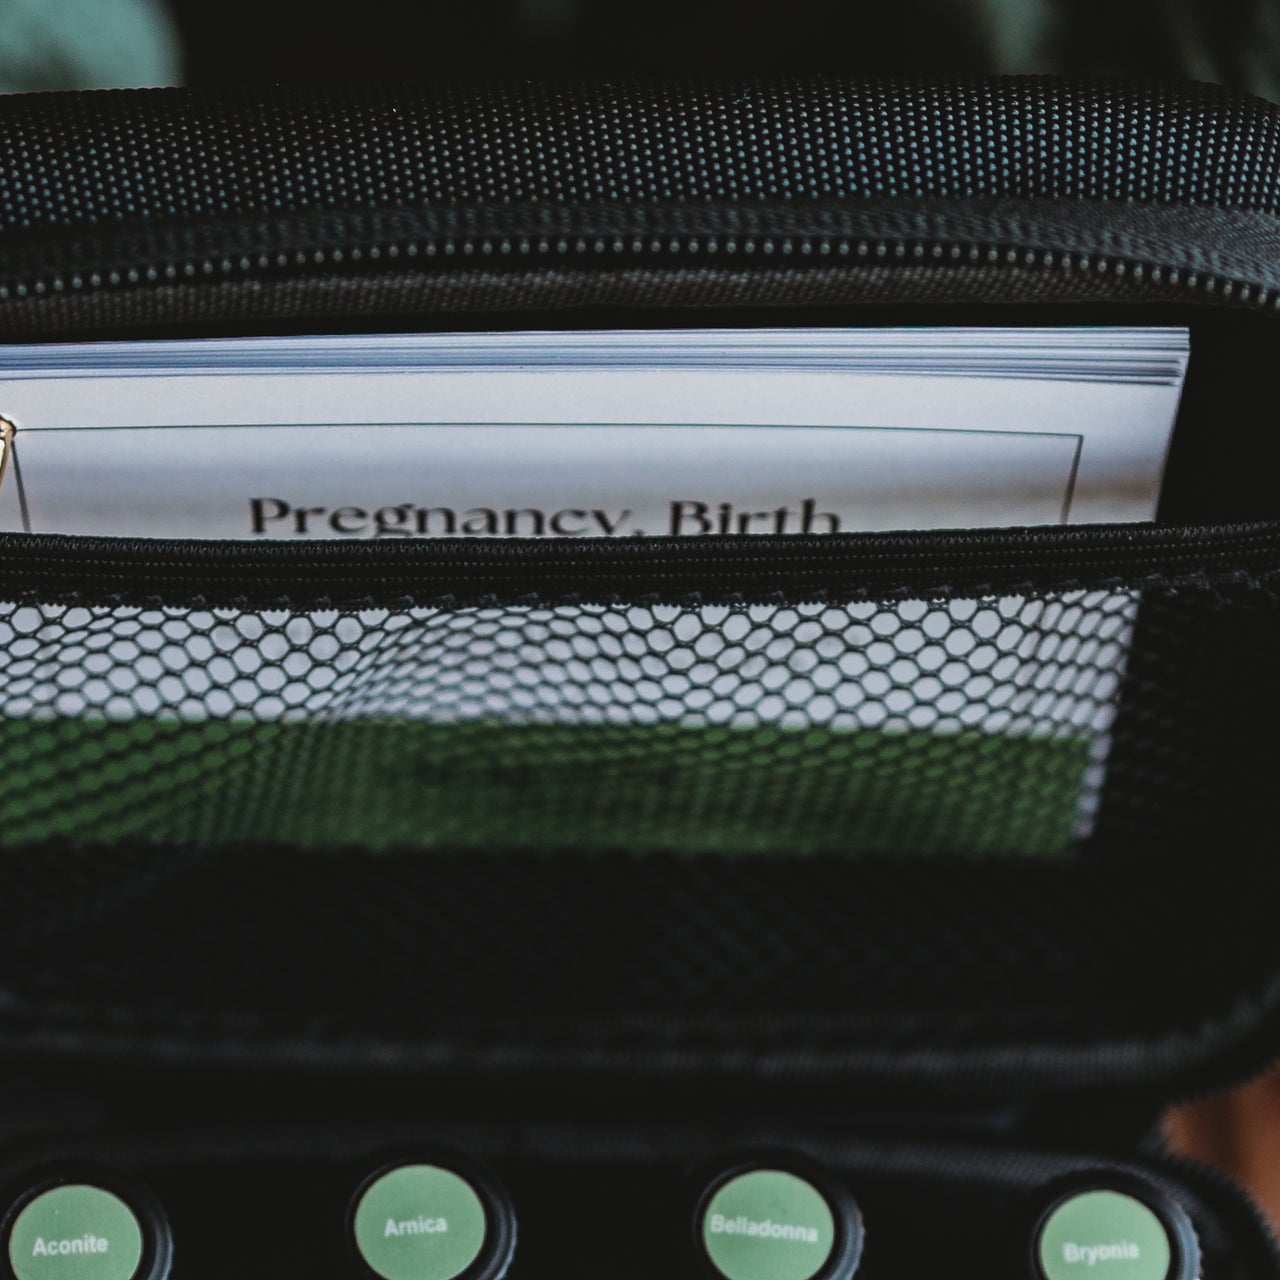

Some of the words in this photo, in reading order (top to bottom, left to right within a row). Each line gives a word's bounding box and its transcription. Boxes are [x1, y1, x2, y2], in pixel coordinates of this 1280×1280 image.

[669, 497, 841, 535] Birth
[384, 1215, 449, 1238] Arnica
[710, 1213, 820, 1244] Belladonna
[32, 1234, 109, 1257] Aconite
[1063, 1240, 1142, 1266] Bryonia
